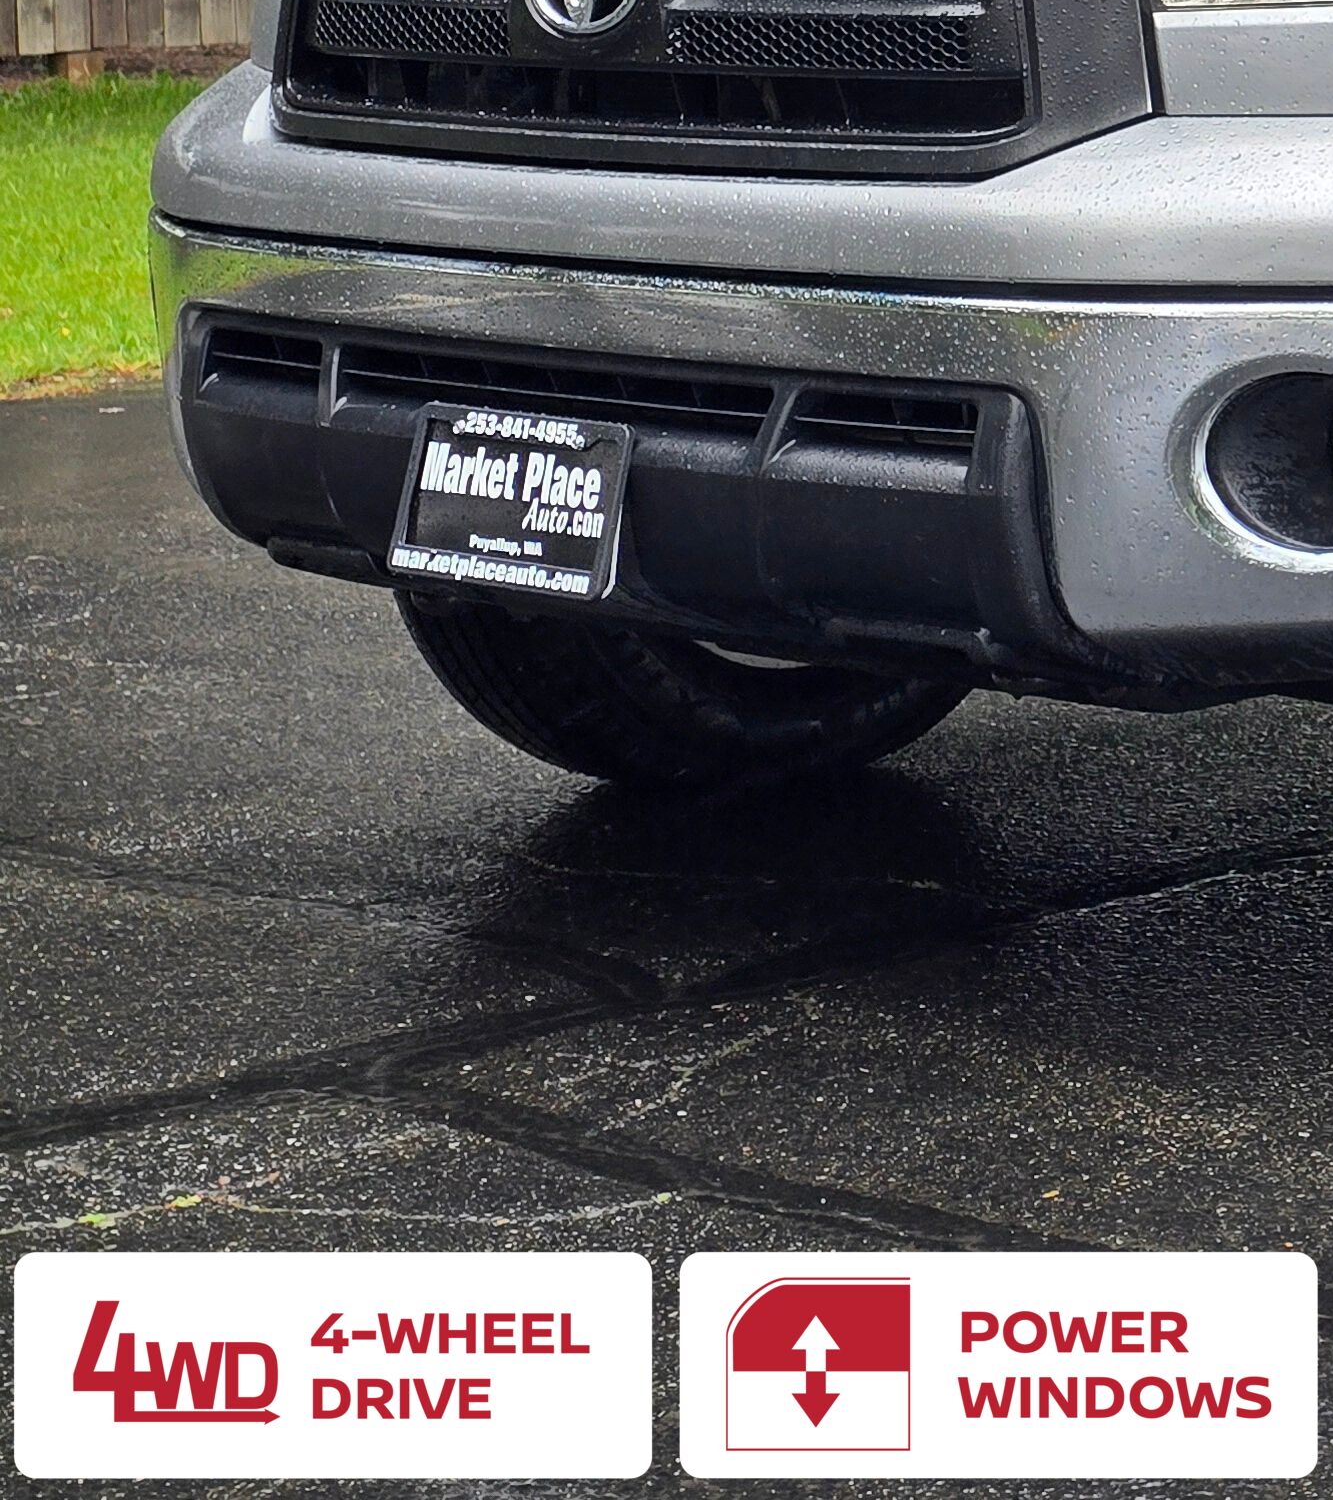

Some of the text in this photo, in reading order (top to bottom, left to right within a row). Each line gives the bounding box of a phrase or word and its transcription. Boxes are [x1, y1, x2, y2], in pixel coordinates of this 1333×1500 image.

[464, 411, 580, 446] 253-841-4955
[421, 441, 601, 510] Market Place
[391, 548, 590, 595] marketplaceauto.com
